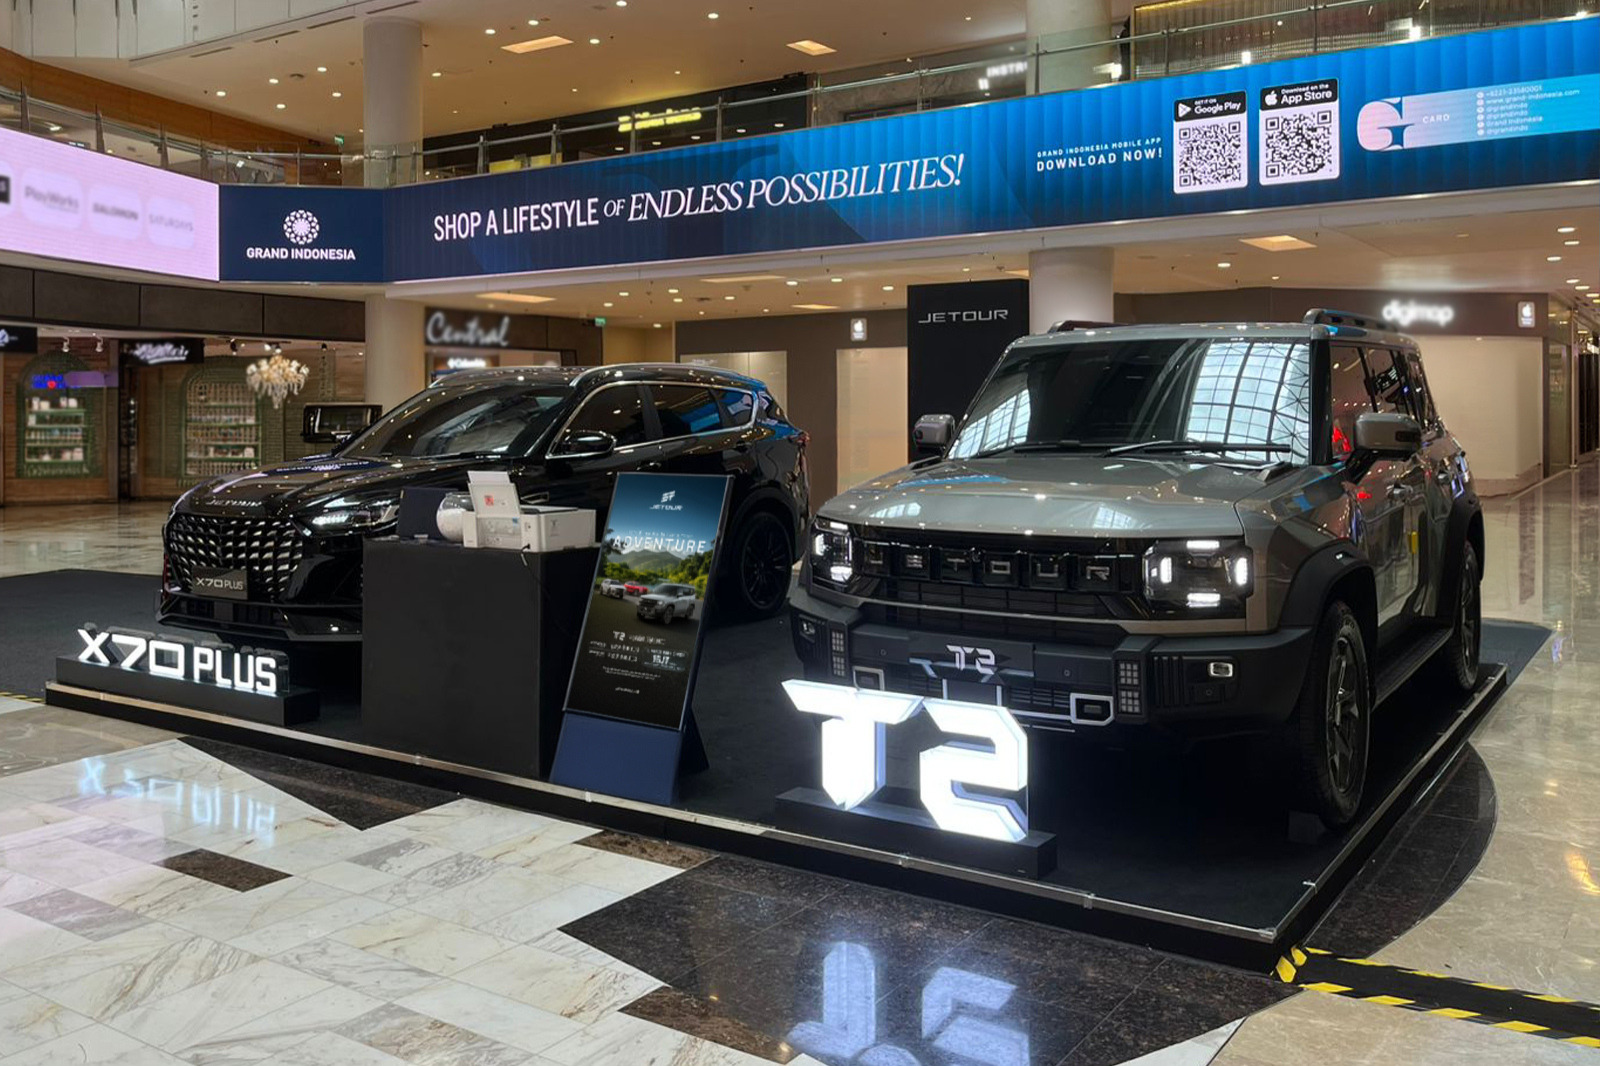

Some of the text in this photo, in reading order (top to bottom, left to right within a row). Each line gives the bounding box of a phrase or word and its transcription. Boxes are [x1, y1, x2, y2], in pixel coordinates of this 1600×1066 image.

[1281, 86, 1309, 94] Download
[1281, 90, 1332, 105] App Store
[1194, 101, 1241, 114] Google Play
[1422, 113, 1450, 124] CARD
[1037, 137, 1161, 158] GRAND INDONESIA MOBILE APP
[1037, 147, 1163, 172] DOWNLOAD NOW!
[433, 153, 965, 241] SHOP A LIFESTYLE OF ENDLESS POSSIBILITIES!
[246, 247, 356, 260] GRAND INDONESIA
[918, 309, 1008, 323] JETOUR
[426, 311, 510, 347] Central
[613, 535, 707, 554] ADVENTURE
[866, 550, 1110, 580] JETOUR
[196, 577, 243, 590] X70 PLUS
[77, 628, 277, 694] X70 PLUS
[946, 644, 995, 675] T2
[781, 679, 1028, 842] T2
